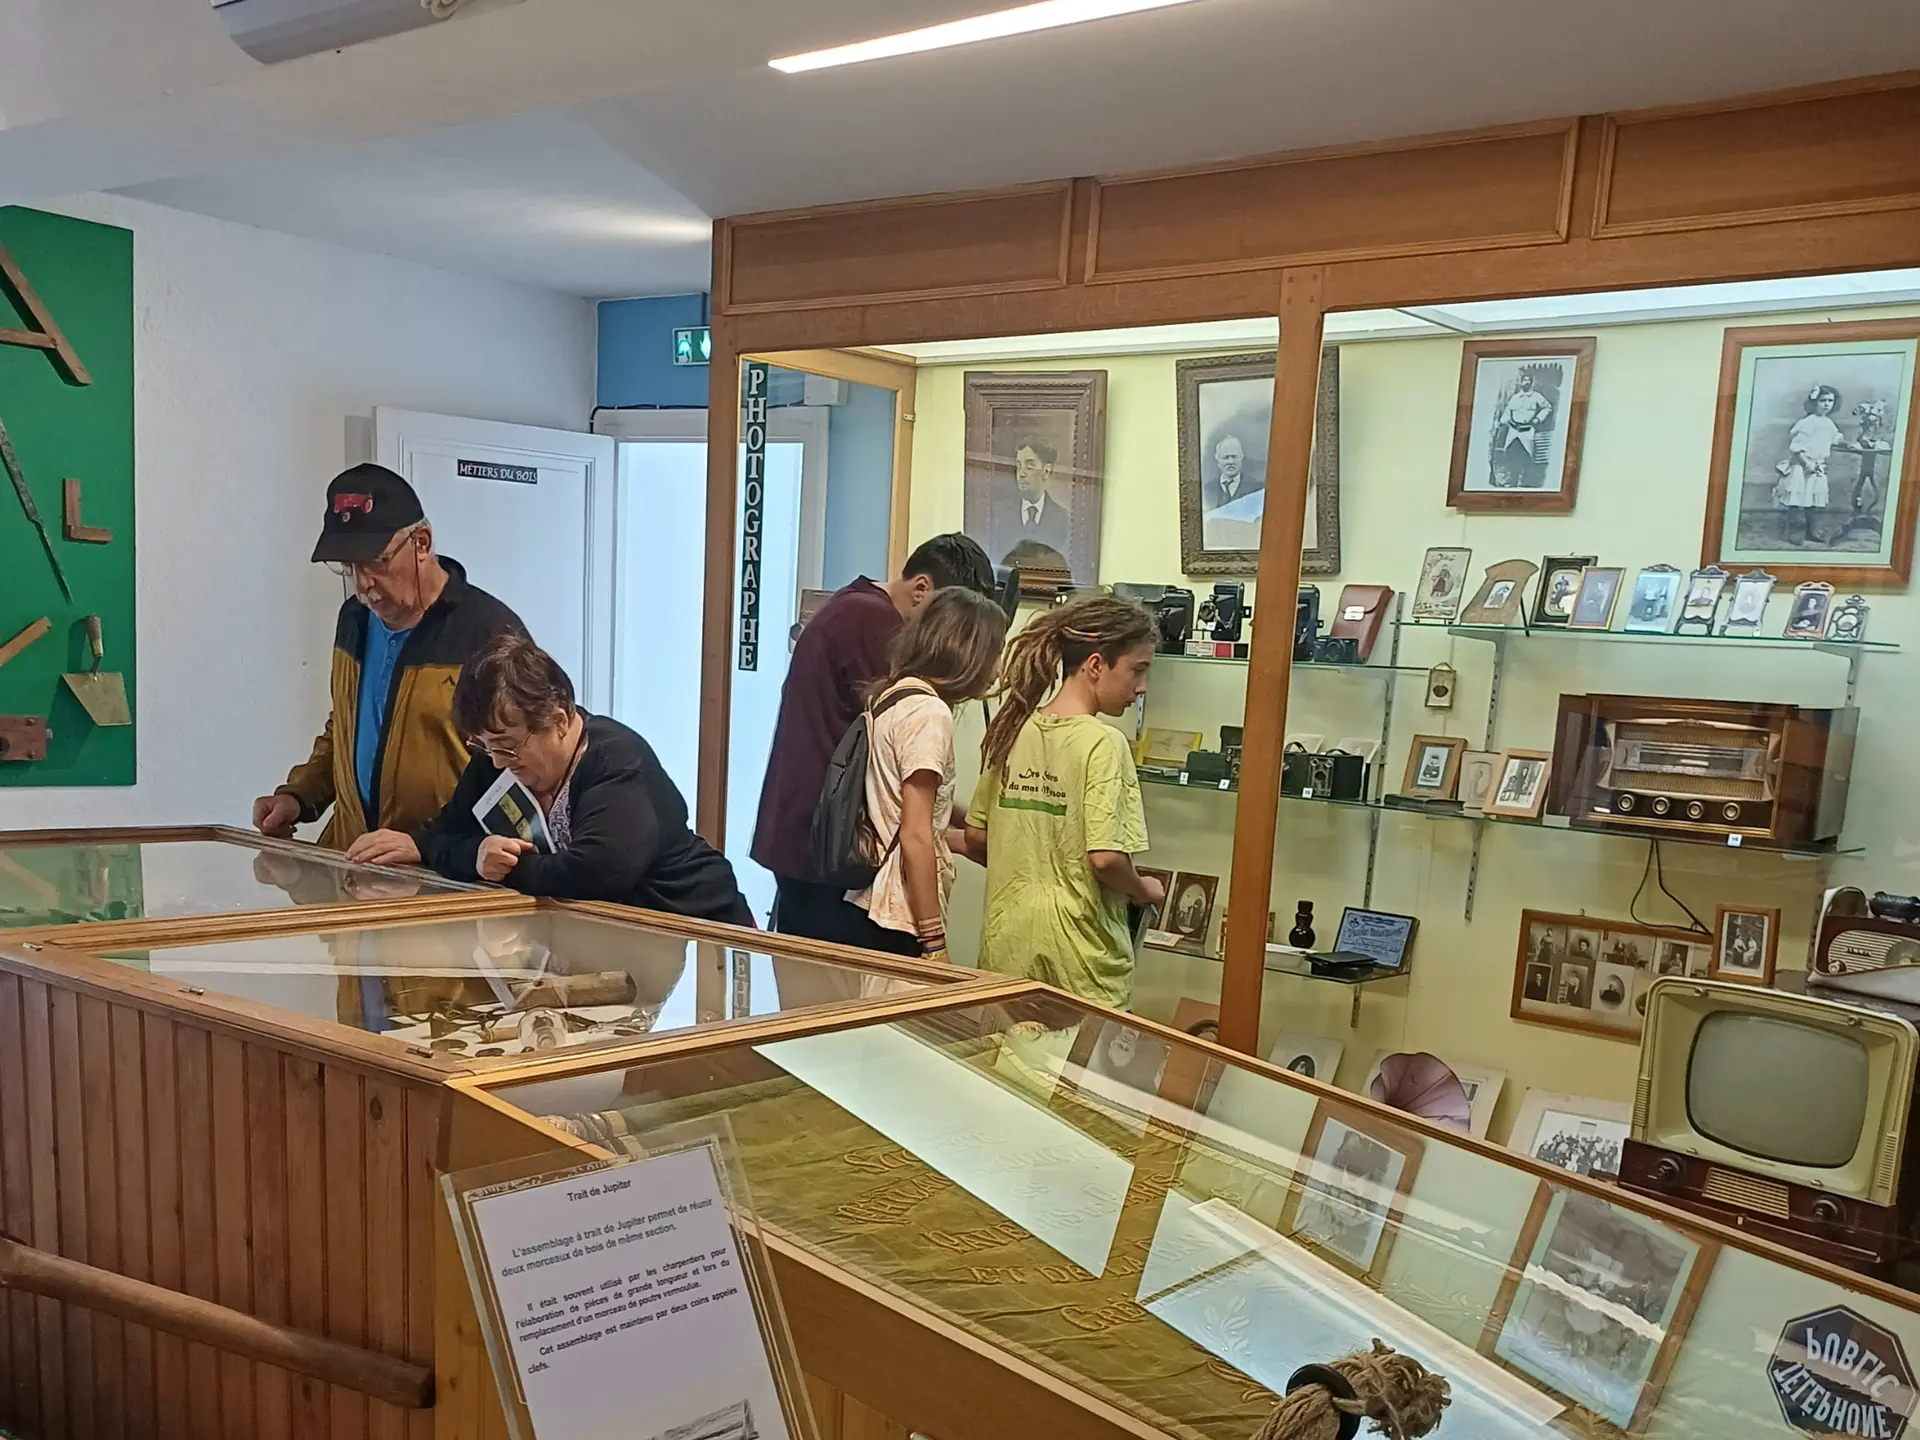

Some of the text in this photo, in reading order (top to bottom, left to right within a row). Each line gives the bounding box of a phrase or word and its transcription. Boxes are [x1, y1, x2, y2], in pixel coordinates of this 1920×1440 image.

[460, 462, 537, 482] MÉTIERS DU BOIS
[740, 368, 767, 670] PHOTOGRAPHE
[567, 1180, 631, 1202] Trait de Jupiter
[502, 1223, 678, 1277] deux morceaux de bois de même section.
[512, 1198, 713, 1258] L'assemblage à trait de Jupiter permet de réunir
[515, 1259, 730, 1329] l'élaboration de pièces de grande longueur et lors du
[527, 1248, 727, 1311] Il était souvent utilisé par les charpentiers pour
[519, 1281, 702, 1342] remplacement d'un morceau de poutre vermoulue.
[539, 1286, 738, 1356] Cet assemblage est maintenu par deux coins appelés
[527, 1361, 551, 1374] clefs.
